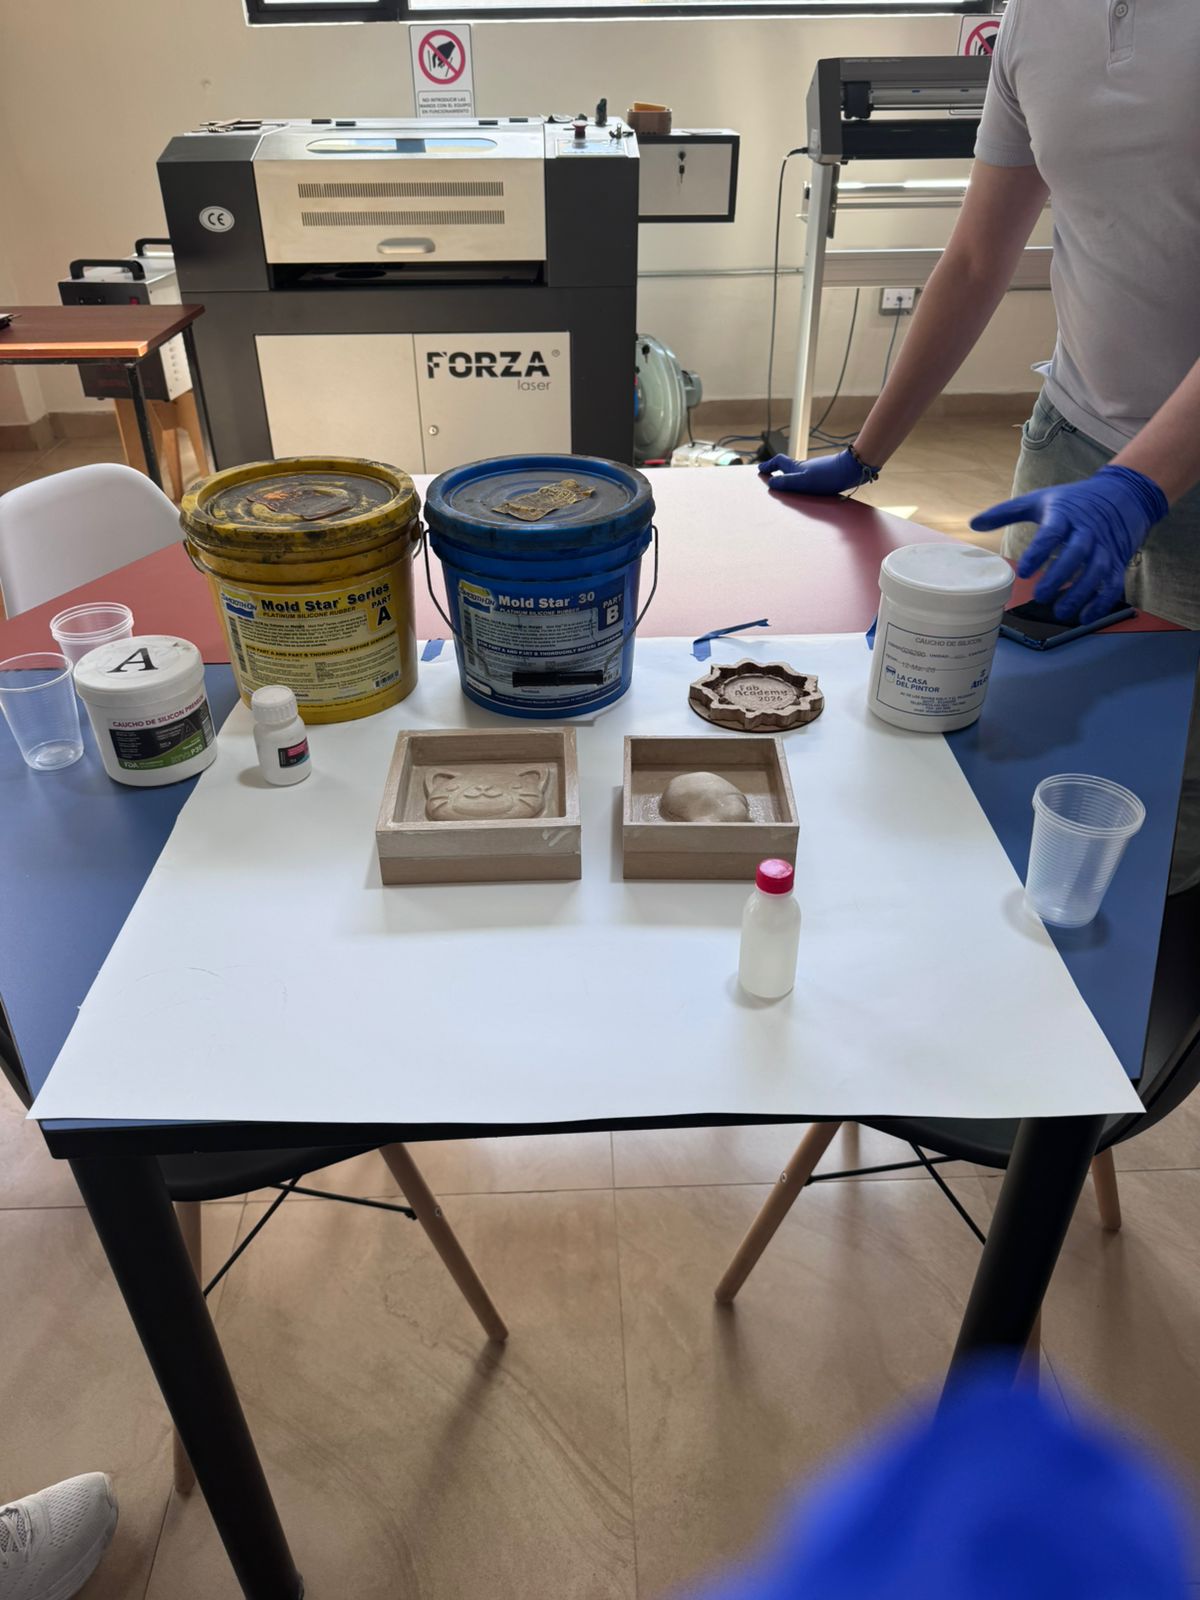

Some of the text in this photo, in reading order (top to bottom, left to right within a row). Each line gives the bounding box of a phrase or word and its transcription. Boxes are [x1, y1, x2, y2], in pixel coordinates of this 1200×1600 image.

[208, 212, 226, 226] CE
[427, 351, 550, 378] FORZA
[517, 380, 551, 391] laser
[261, 599, 300, 612] Mold
[346, 583, 390, 605] Series
[371, 594, 392, 608] PART
[498, 595, 534, 609] Mold
[578, 591, 595, 604] 30
[603, 594, 623, 608] PART
[296, 610, 328, 619] SILICONE
[329, 606, 356, 616] RUBBER
[377, 606, 392, 626] A
[606, 604, 619, 625] B
[914, 637, 946, 647] CAUCHO
[309, 648, 349, 658] THOROUGHLY
[349, 641, 370, 652] BEFORE
[105, 647, 159, 674] A
[896, 673, 928, 685] LA CASA
[734, 689, 788, 697] Academy
[895, 680, 941, 693] DEL PINTOR
[112, 721, 145, 729] CAUCHO
[158, 710, 184, 723] SILICON
